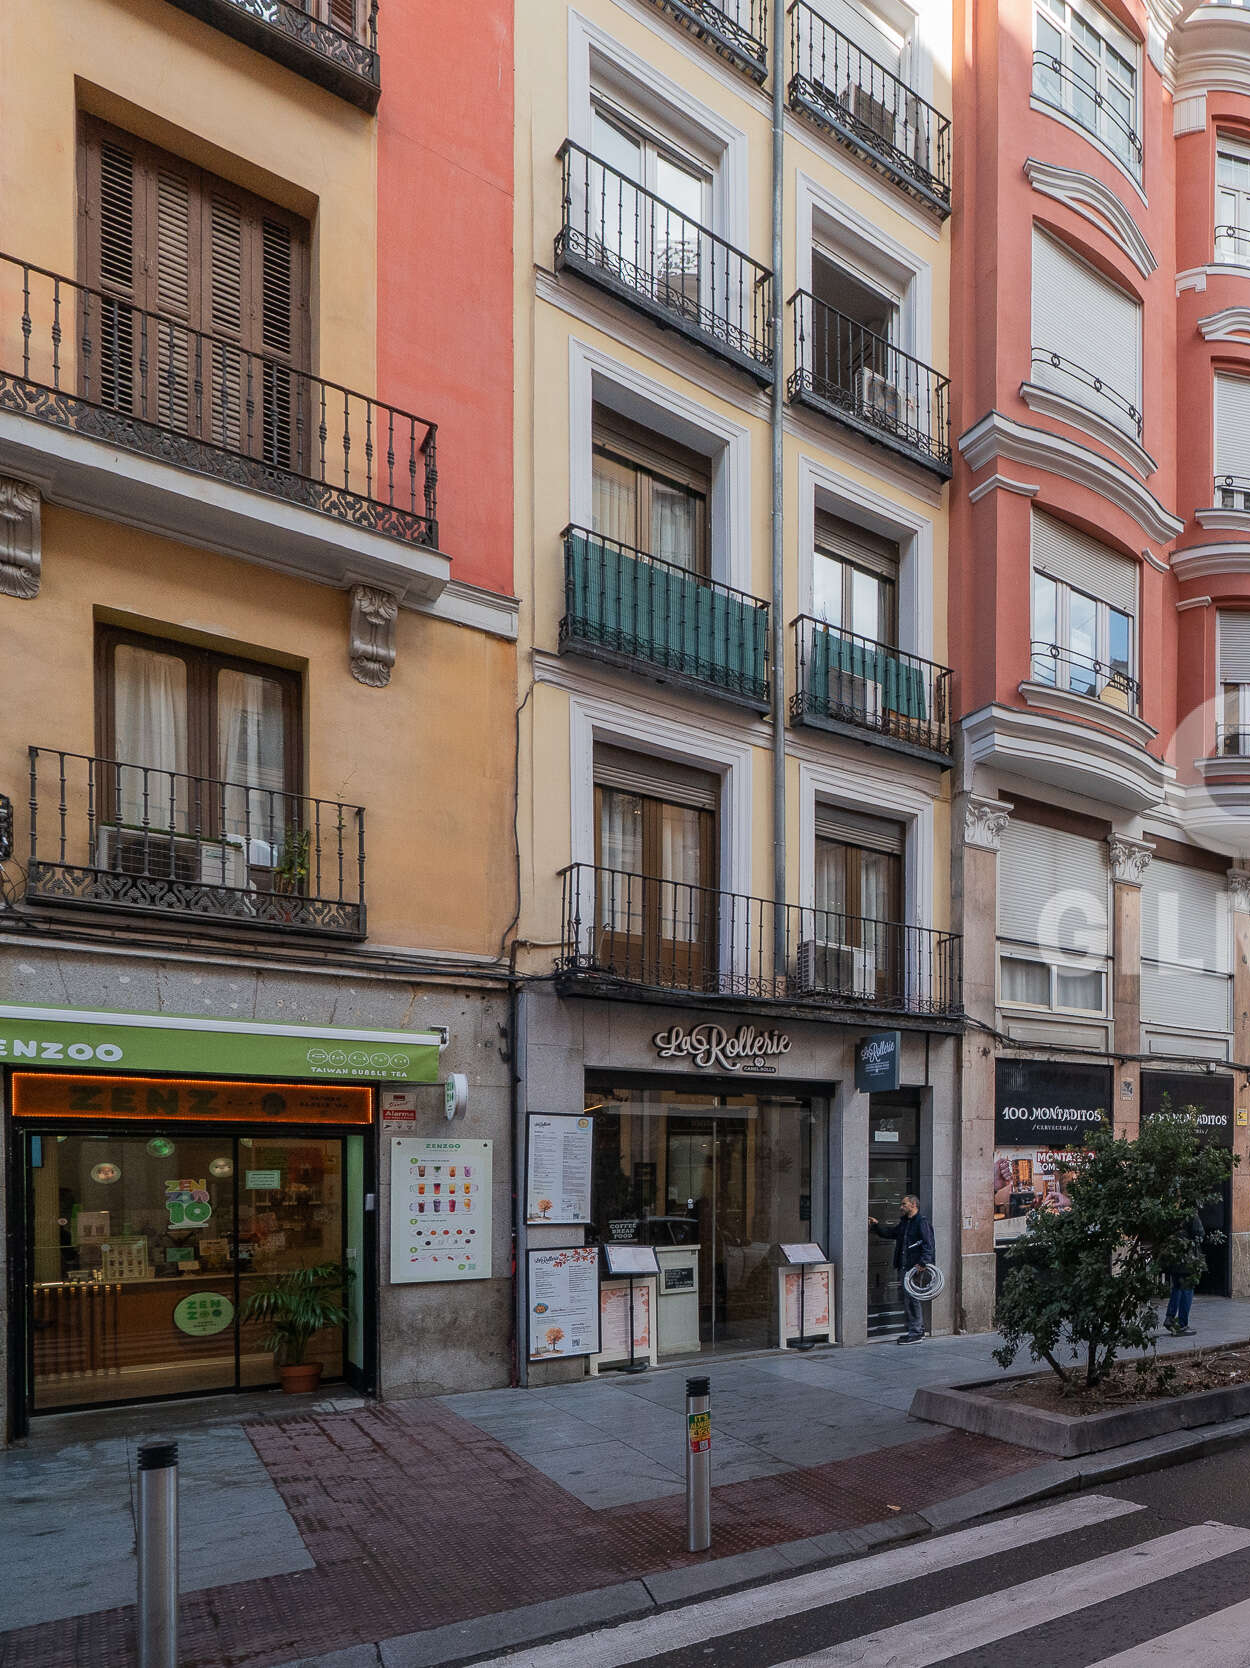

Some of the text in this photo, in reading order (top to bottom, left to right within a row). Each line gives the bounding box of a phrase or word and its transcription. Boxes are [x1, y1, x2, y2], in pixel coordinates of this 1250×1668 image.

[691, 1023, 792, 1070] Rollerie
[311, 1066, 348, 1075] TAIWAN
[351, 1068, 387, 1077] BUBBLE
[1002, 1105, 1102, 1122] 100 MONTADITOS
